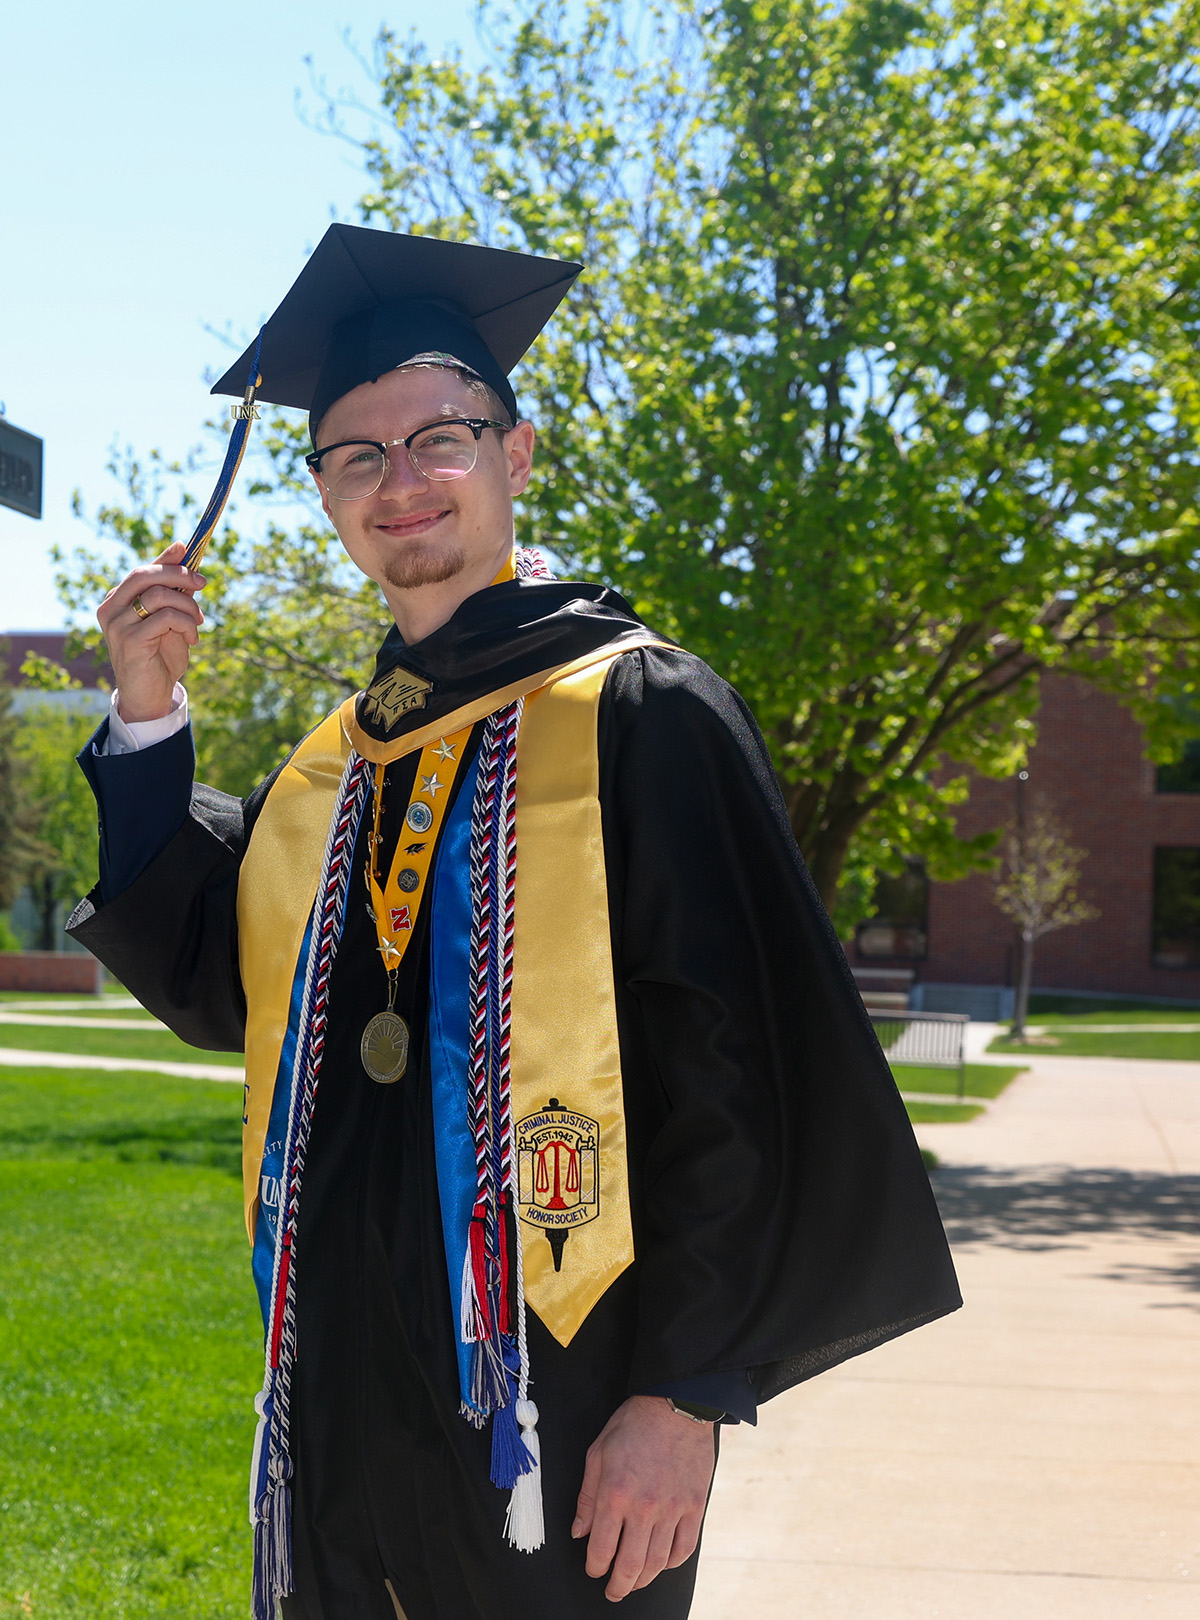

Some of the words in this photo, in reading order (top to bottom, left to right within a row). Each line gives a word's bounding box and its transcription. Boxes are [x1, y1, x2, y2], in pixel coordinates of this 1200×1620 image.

[230, 404, 261, 420] UNK
[518, 1113, 557, 1135] CRIMINAL
[557, 1113, 596, 1134] JUSTICE
[267, 1213, 278, 1226] 19
[526, 1206, 555, 1225] HONOR
[554, 1205, 588, 1225] SOCIETY
